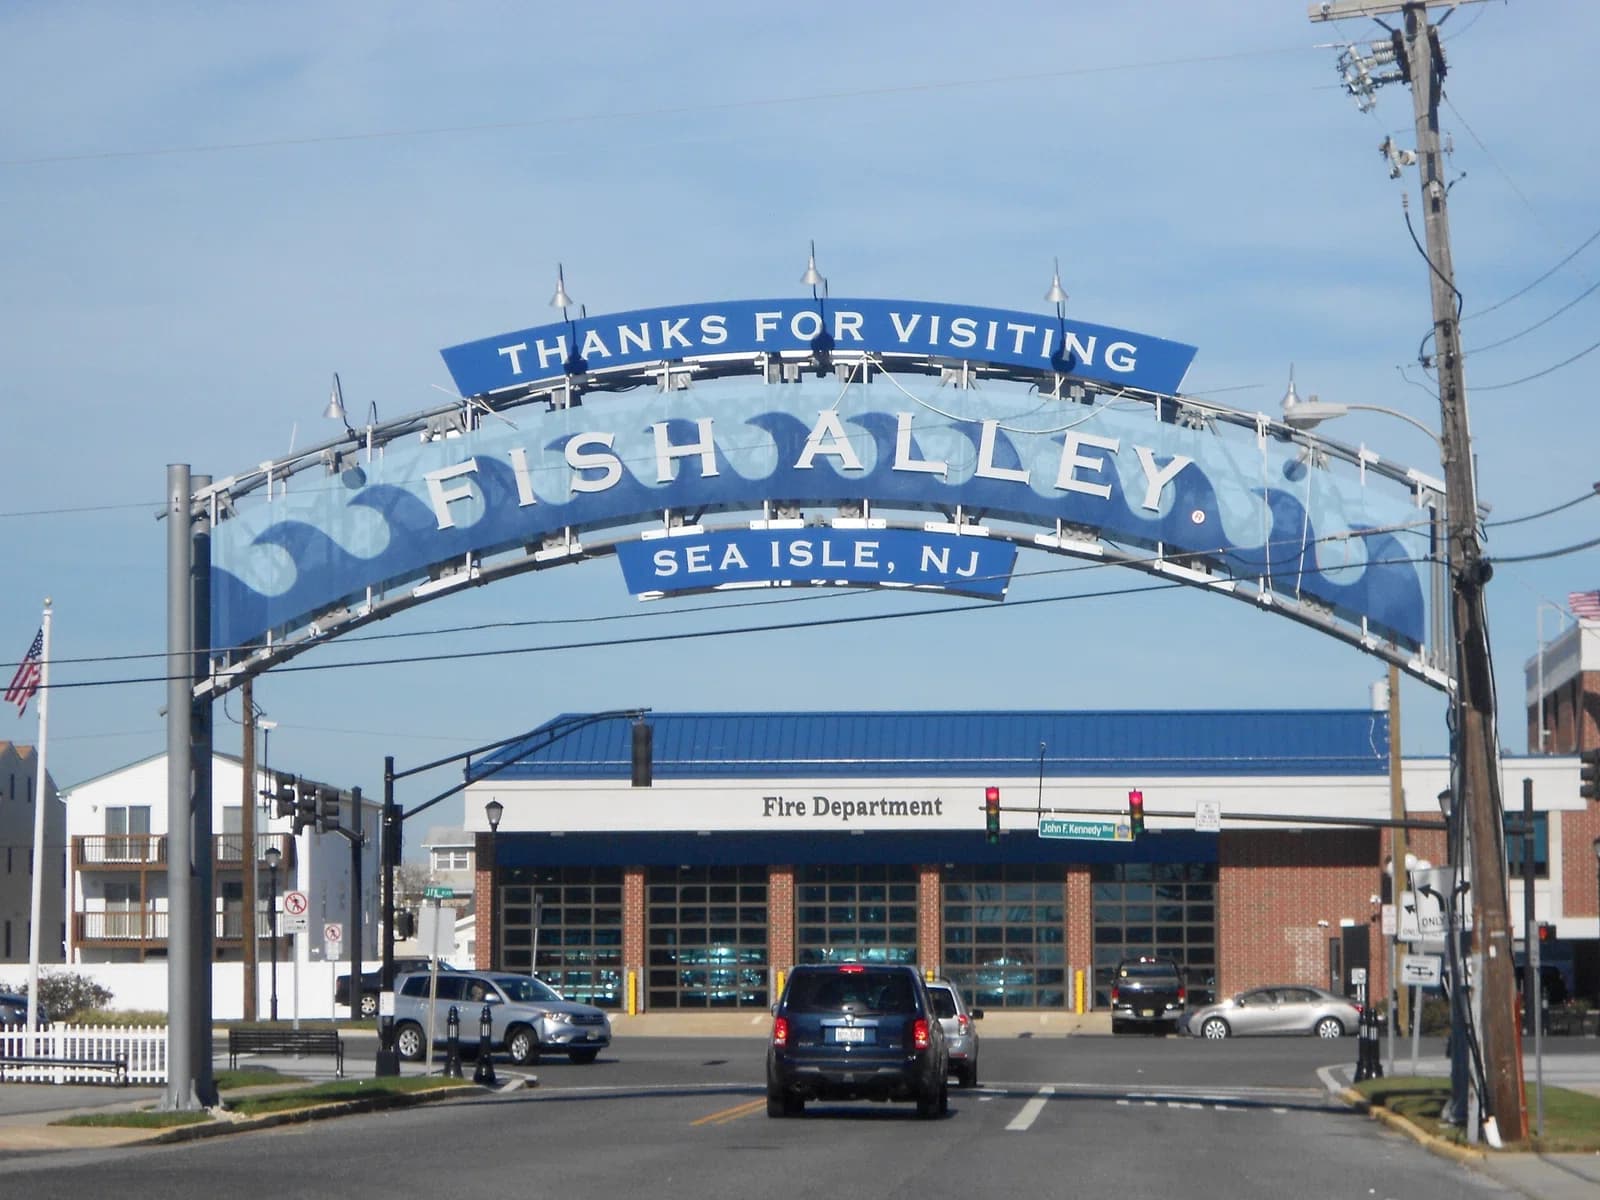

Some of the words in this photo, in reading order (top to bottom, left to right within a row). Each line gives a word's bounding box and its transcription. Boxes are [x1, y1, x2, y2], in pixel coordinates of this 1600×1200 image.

[498, 314, 728, 375] THANKS
[755, 310, 864, 342] FOR
[889, 312, 1138, 373] VISITING
[423, 417, 720, 530] FISH
[793, 409, 1194, 513] ALLEY
[653, 543, 749, 576] SEA
[770, 540, 895, 574] ISLE,
[920, 545, 979, 577] NJ
[762, 796, 806, 816] Fire
[812, 796, 943, 821] Department
[1042, 822, 1061, 833] John
[1062, 823, 1069, 834] F.
[1069, 823, 1102, 837] Kennedy
[1422, 914, 1446, 927] ONLY
